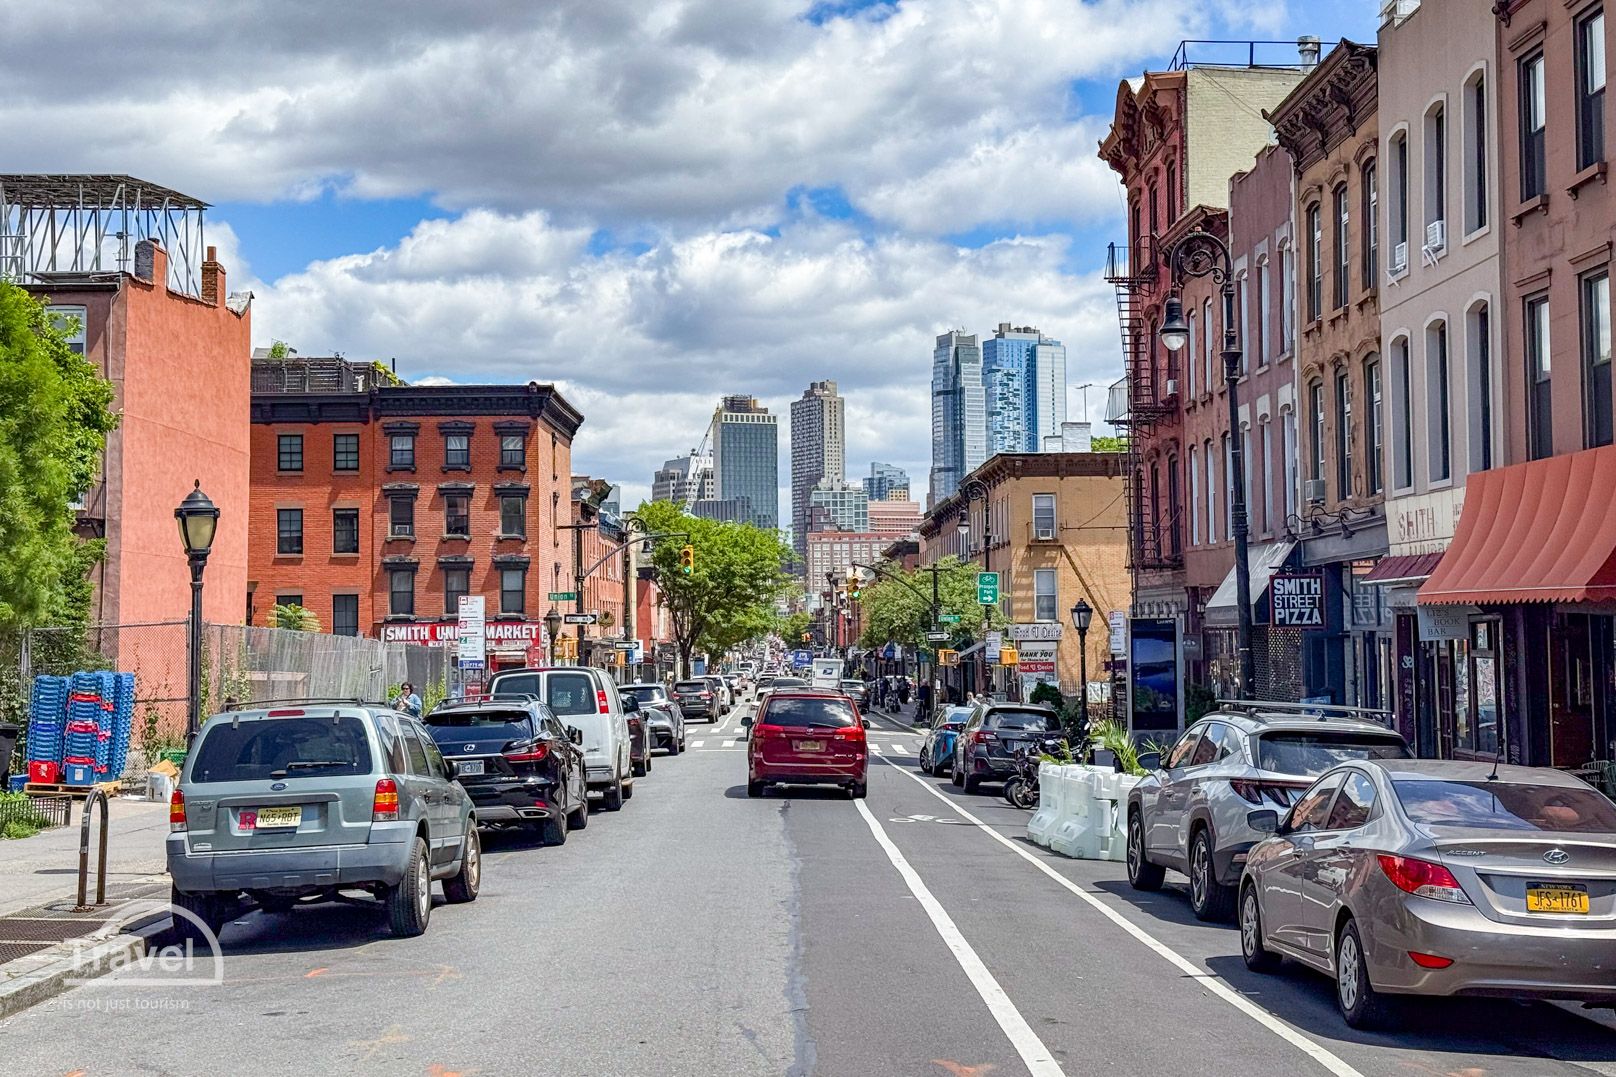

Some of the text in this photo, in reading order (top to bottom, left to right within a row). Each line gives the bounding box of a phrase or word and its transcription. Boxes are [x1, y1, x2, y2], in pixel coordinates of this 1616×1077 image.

[1273, 578, 1321, 595] SMITH
[1274, 594, 1321, 608] STREET
[1275, 608, 1322, 625] PIZZA
[1434, 617, 1460, 626] BOOK
[386, 626, 429, 641] SMITH
[436, 626, 459, 640] UNI
[486, 624, 538, 640] MARKET
[1427, 627, 1447, 636] BAR
[1446, 849, 1486, 857] ACCENT
